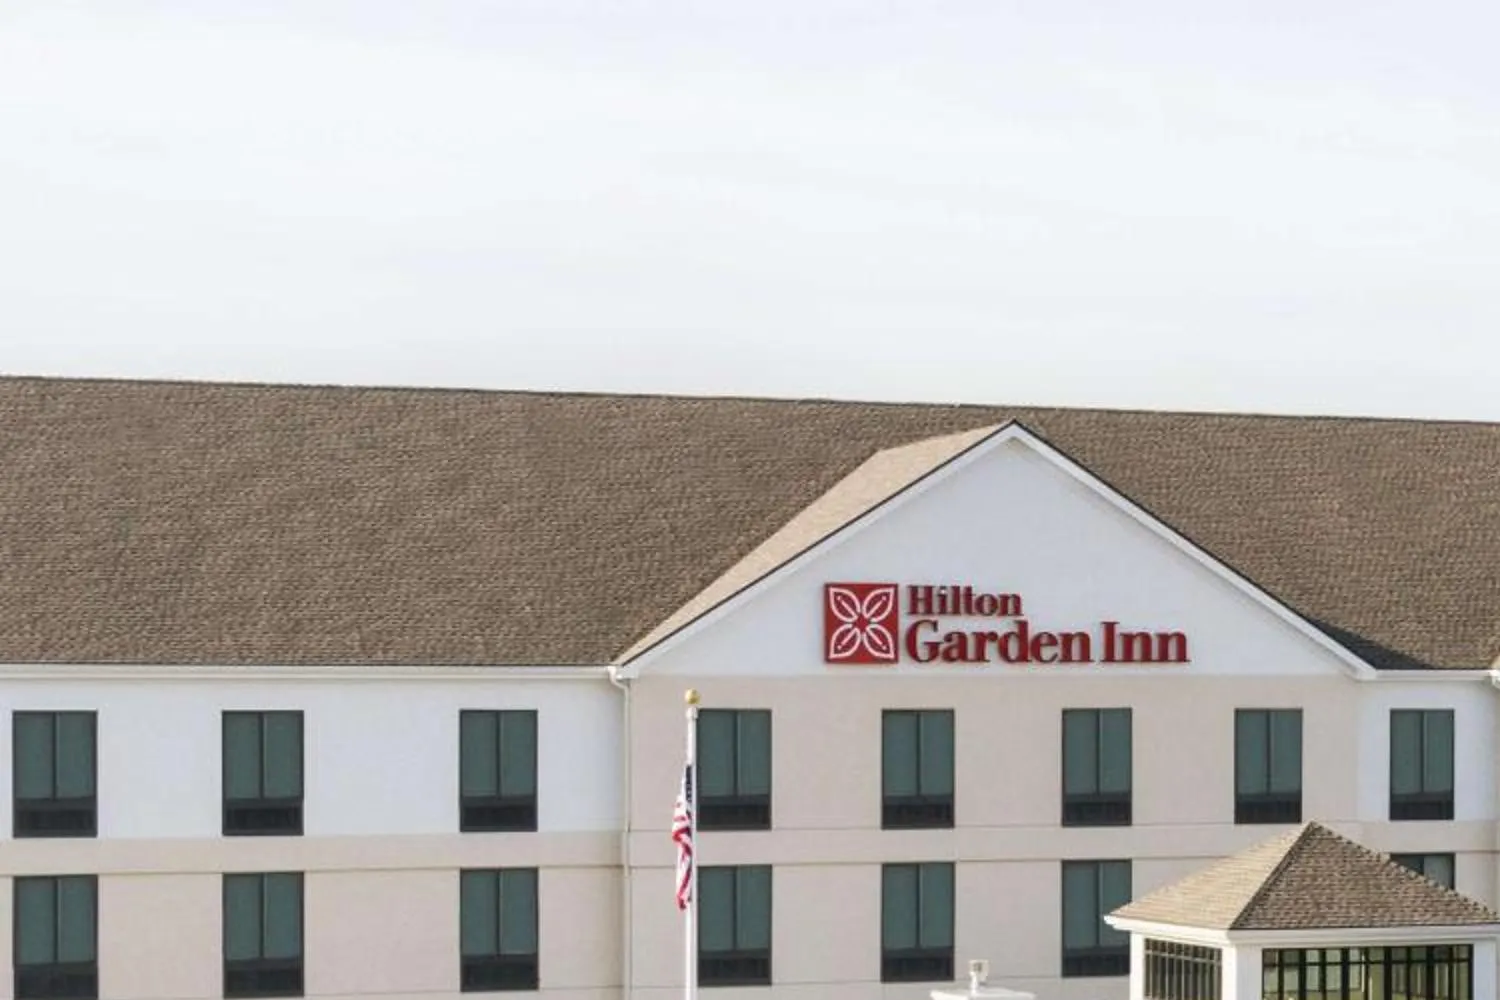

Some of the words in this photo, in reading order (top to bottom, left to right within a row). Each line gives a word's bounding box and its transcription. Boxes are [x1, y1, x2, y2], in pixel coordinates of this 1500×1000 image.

[906, 584, 1024, 617] Hilton
[904, 619, 1095, 664] Garden
[1099, 621, 1191, 663] Inn
